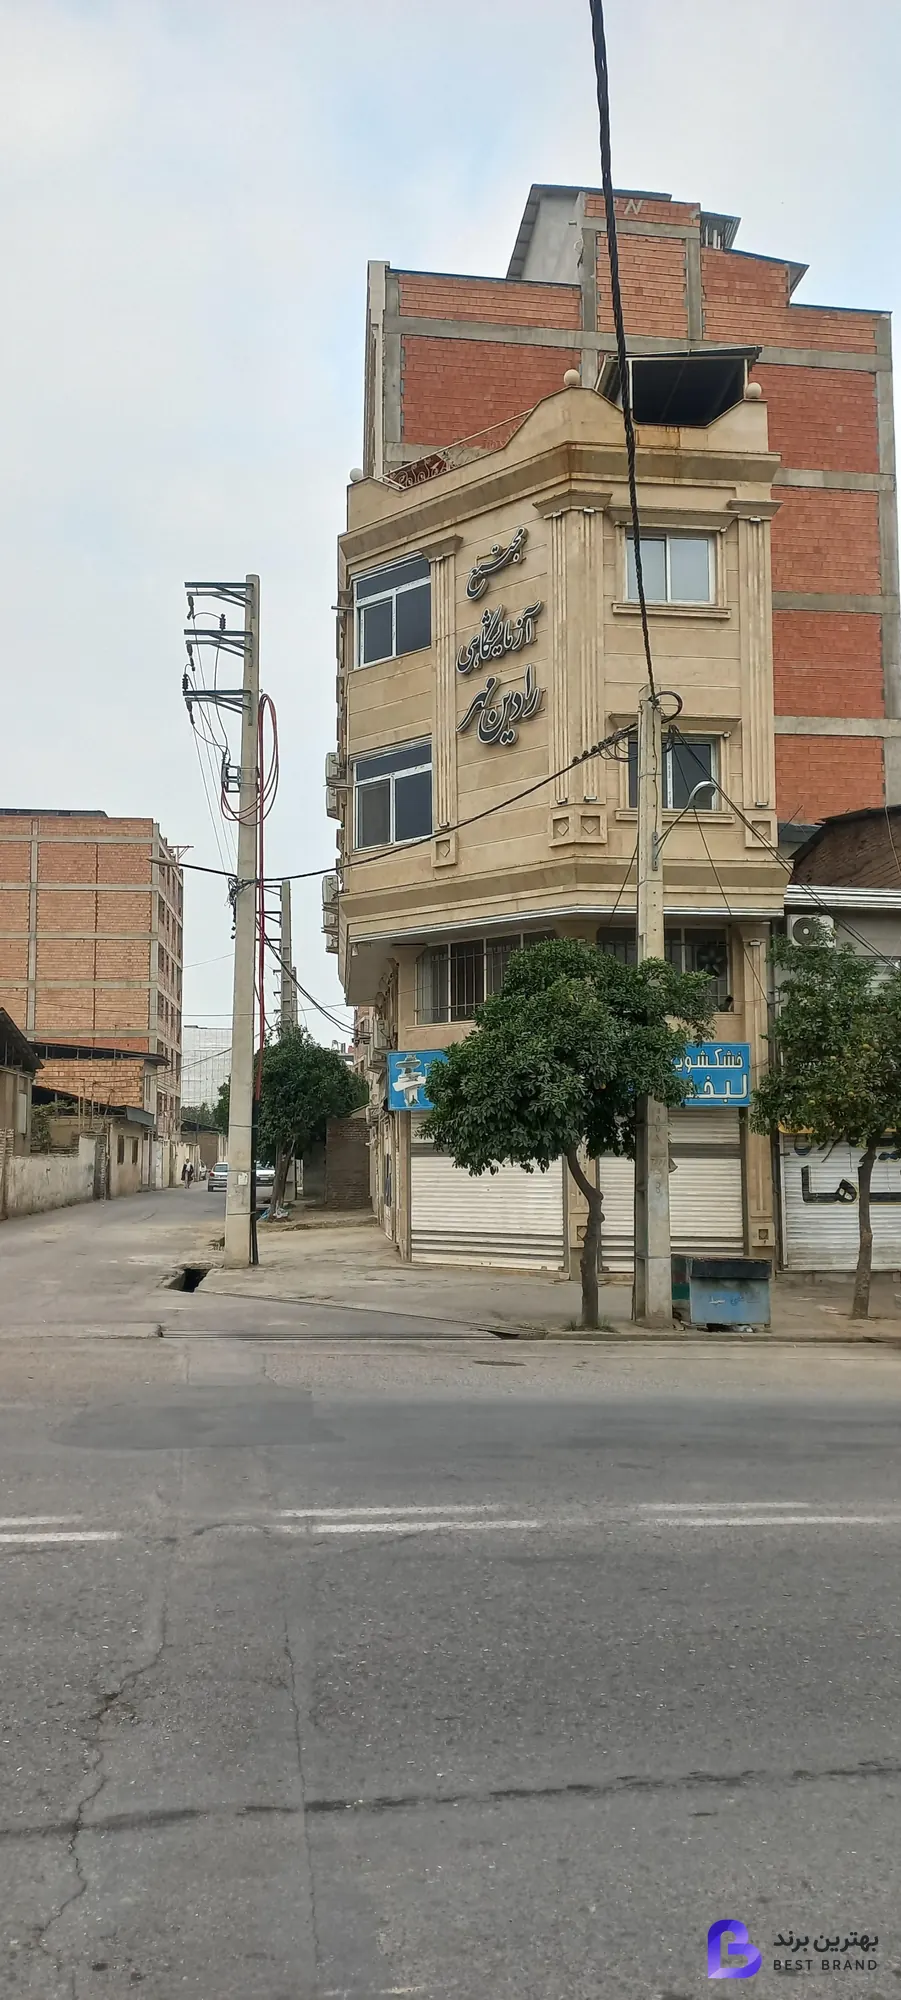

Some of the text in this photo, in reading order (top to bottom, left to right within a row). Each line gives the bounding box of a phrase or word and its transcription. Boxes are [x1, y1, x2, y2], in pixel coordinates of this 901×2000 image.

[466, 526, 528, 599] مجتمع
[456, 600, 545, 674] آزمایشگاهی
[456, 664, 541, 745] رادین مهر
[671, 1048, 743, 1073] خشکشوی
[685, 1074, 748, 1103] لبخن
